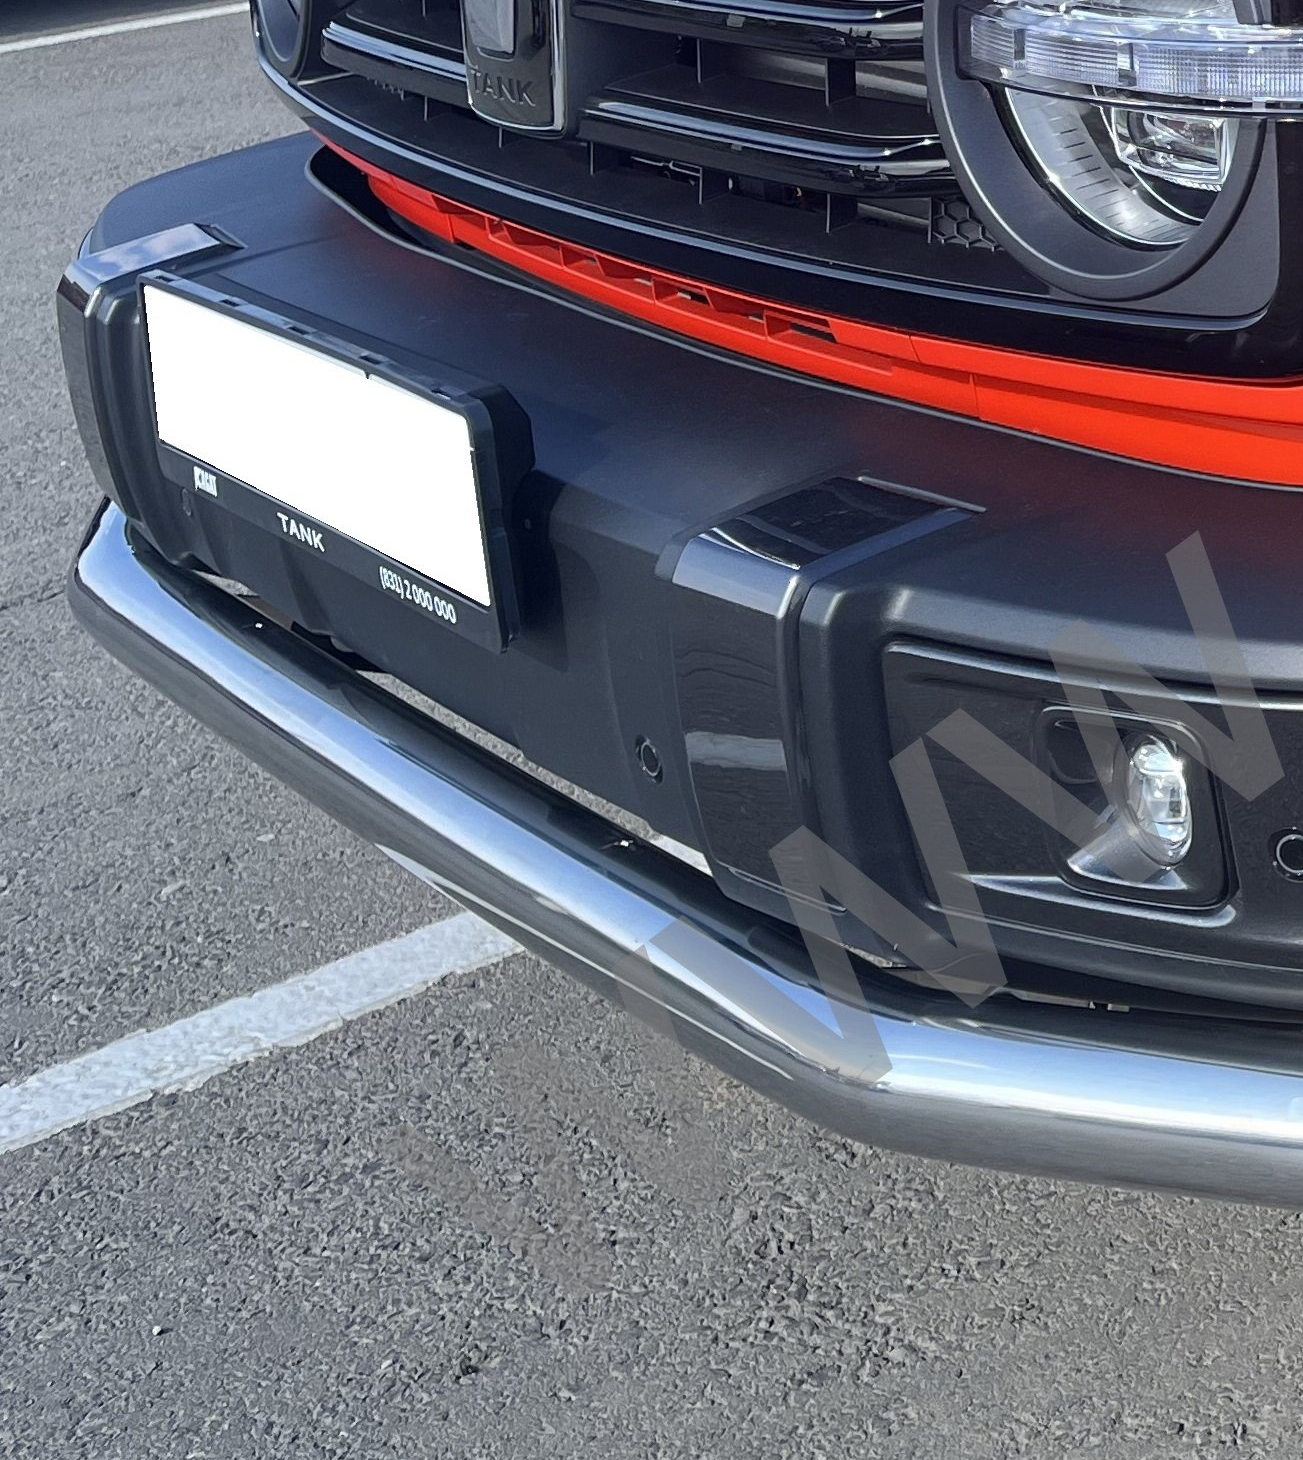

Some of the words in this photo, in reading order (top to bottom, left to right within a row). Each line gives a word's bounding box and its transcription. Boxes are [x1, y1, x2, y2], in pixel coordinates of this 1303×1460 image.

[469, 68, 536, 107] TANK
[277, 512, 326, 552] TANK
[379, 566, 404, 600] (831)
[404, 580, 413, 600] 2
[412, 584, 433, 612] 000
[433, 596, 457, 624] 000
